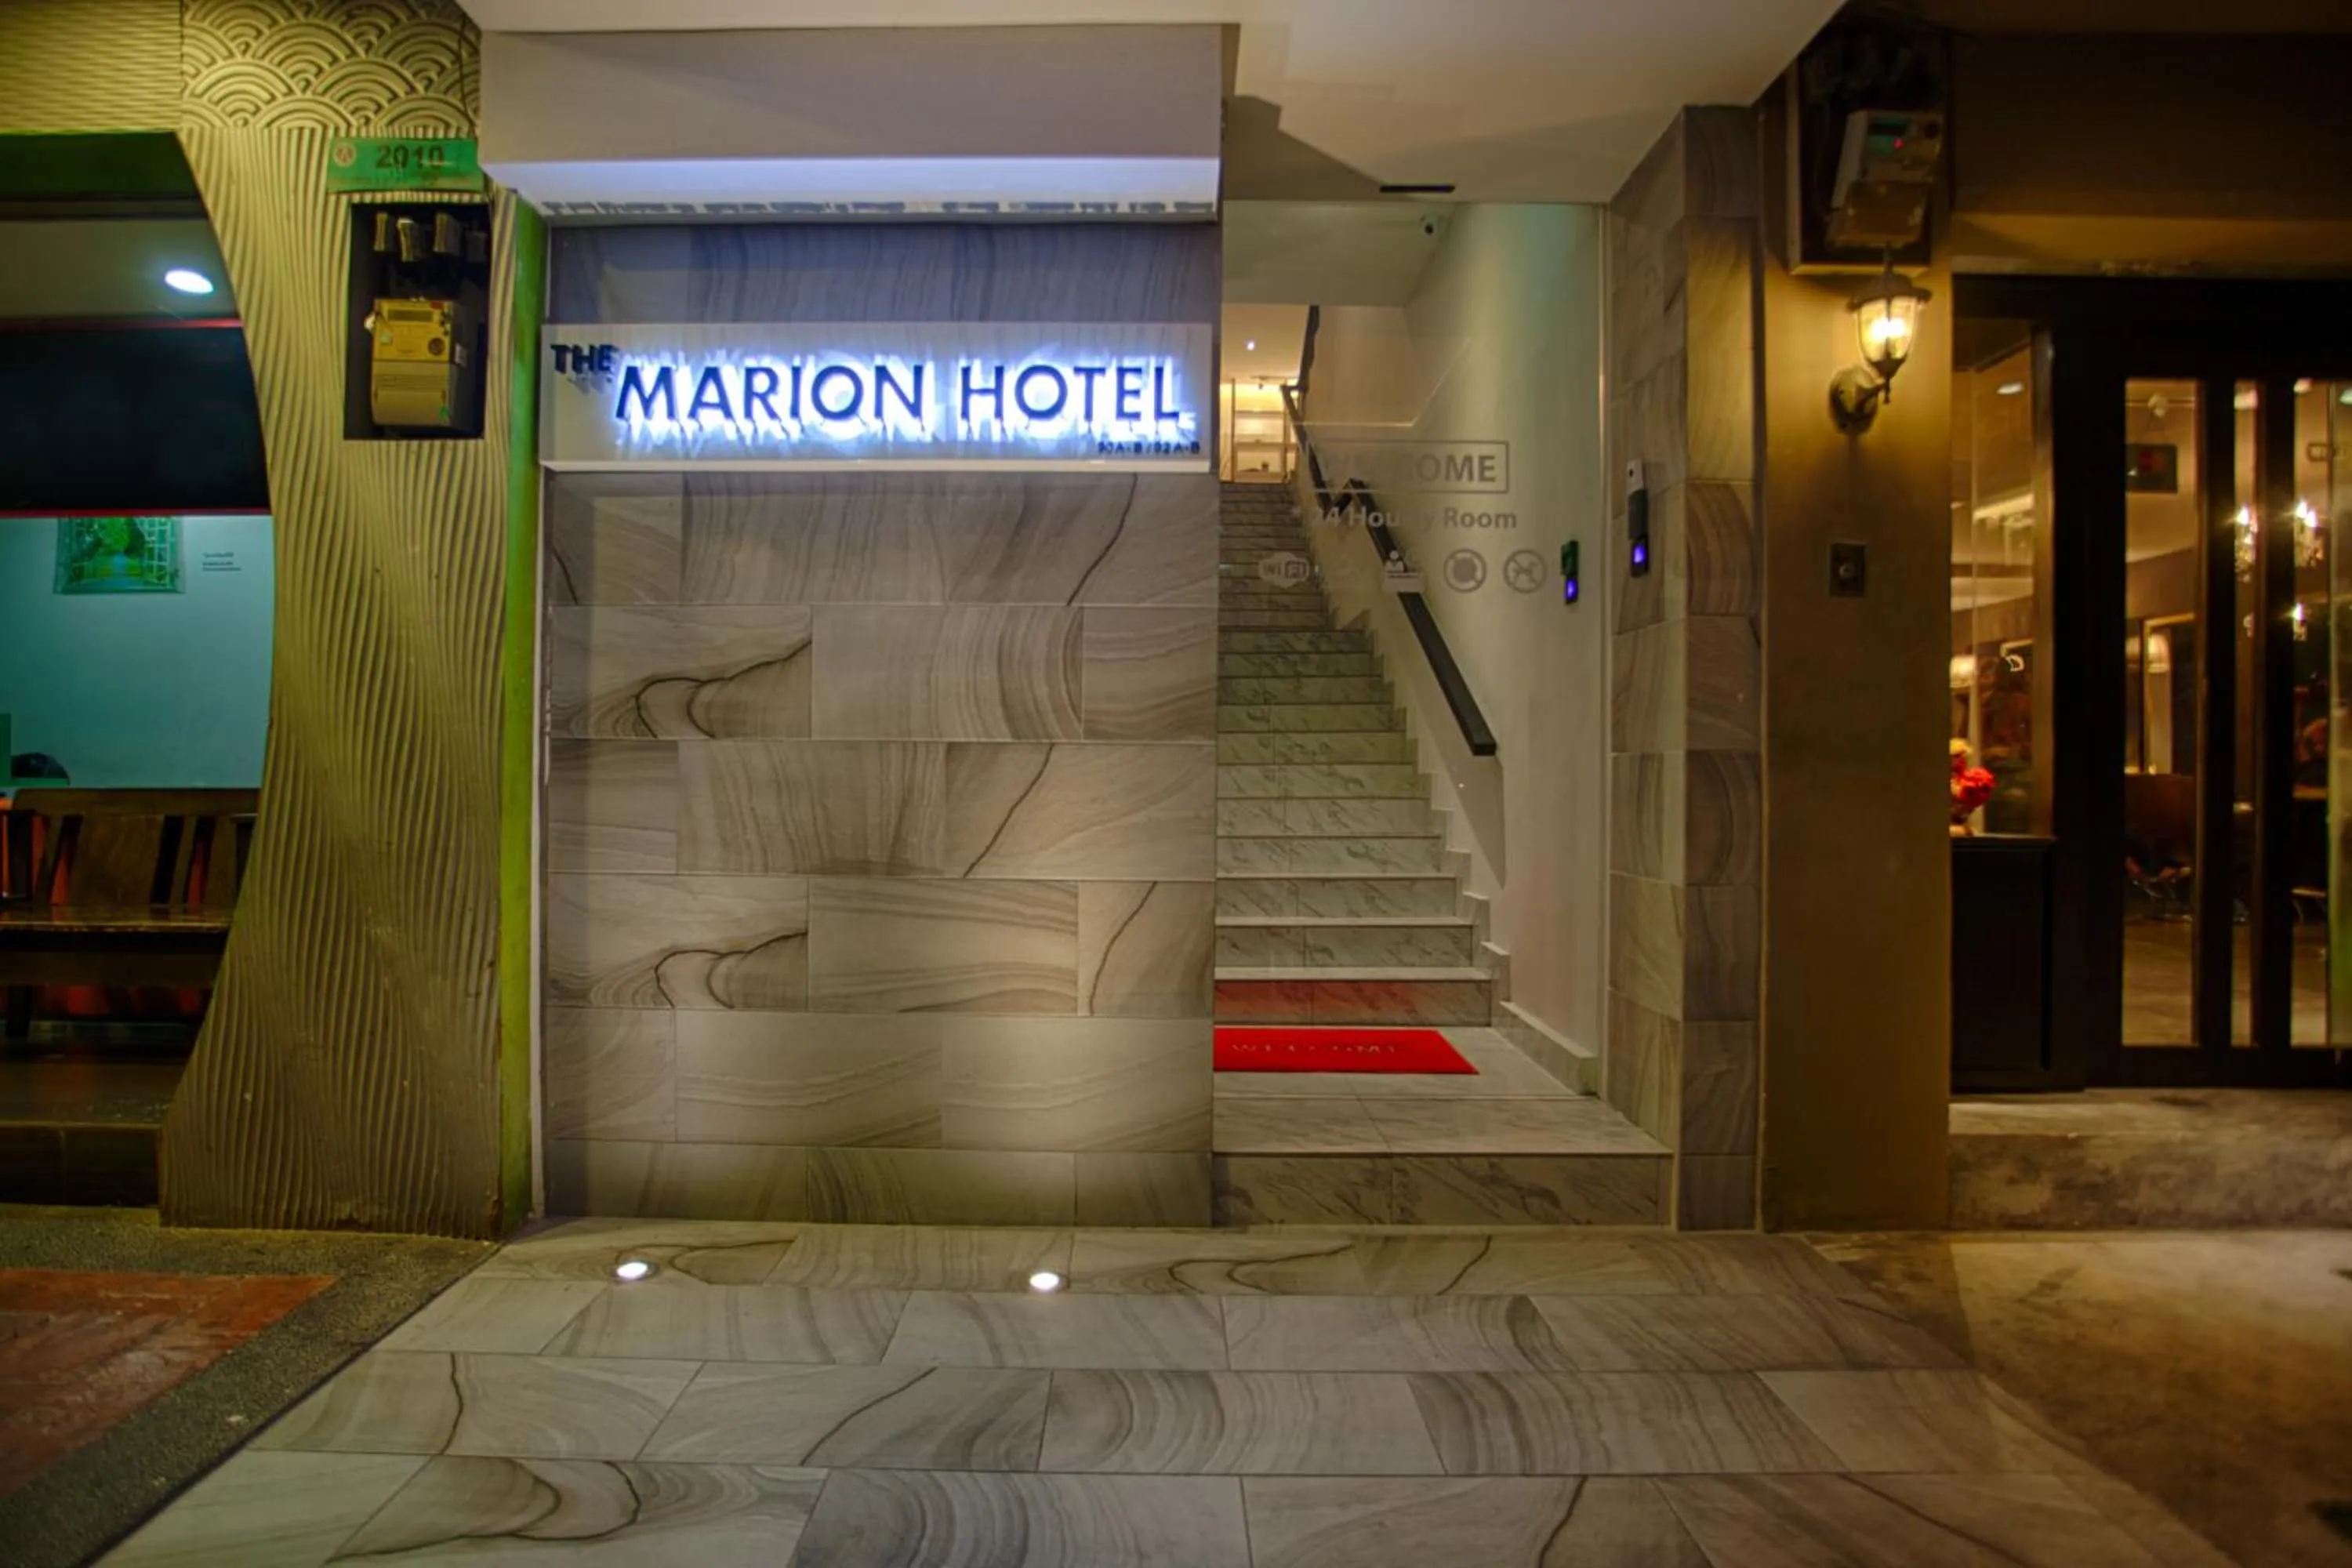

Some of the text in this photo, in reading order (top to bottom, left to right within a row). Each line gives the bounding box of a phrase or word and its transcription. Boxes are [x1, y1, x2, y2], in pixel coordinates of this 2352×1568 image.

[550, 343, 615, 374] THE
[615, 365, 1180, 422] MARION HOTEL
[1348, 506, 1436, 534] Houy
[1443, 507, 1518, 529] Room
